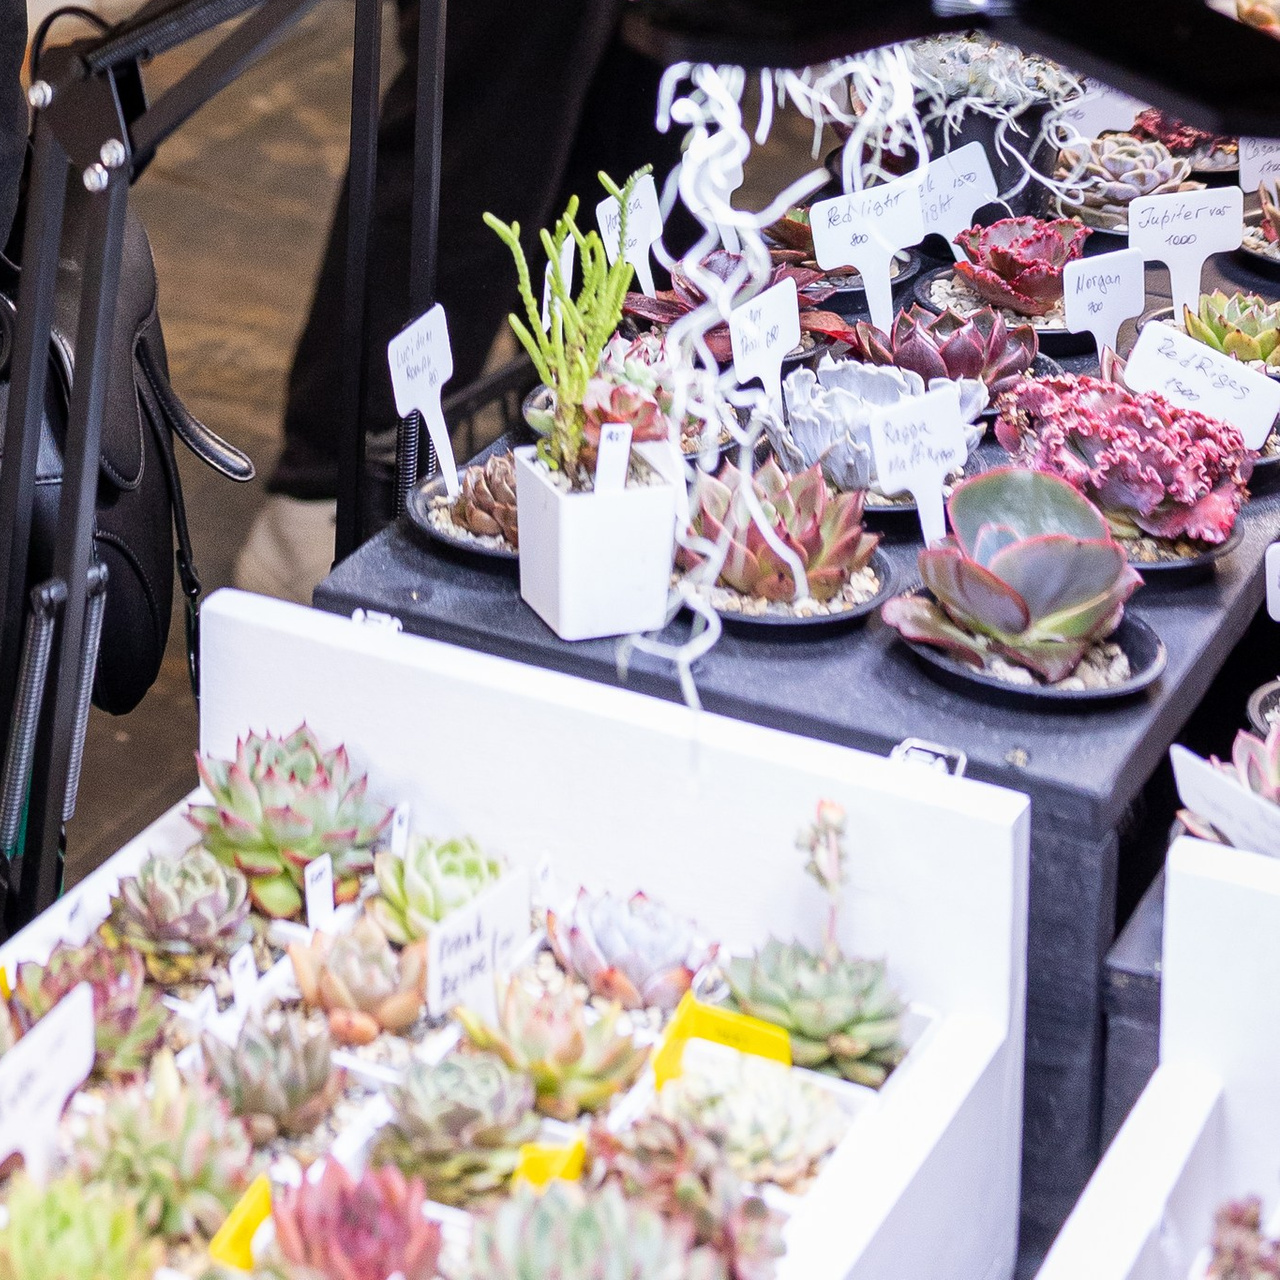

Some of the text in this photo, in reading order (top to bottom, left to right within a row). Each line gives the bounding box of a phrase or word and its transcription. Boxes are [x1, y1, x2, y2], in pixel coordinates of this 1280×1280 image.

[1138, 203, 1208, 230] Jupiter
[849, 232, 869, 247] 800
[1164, 233, 1198, 246] 1000
[1087, 301, 1104, 316] 700
